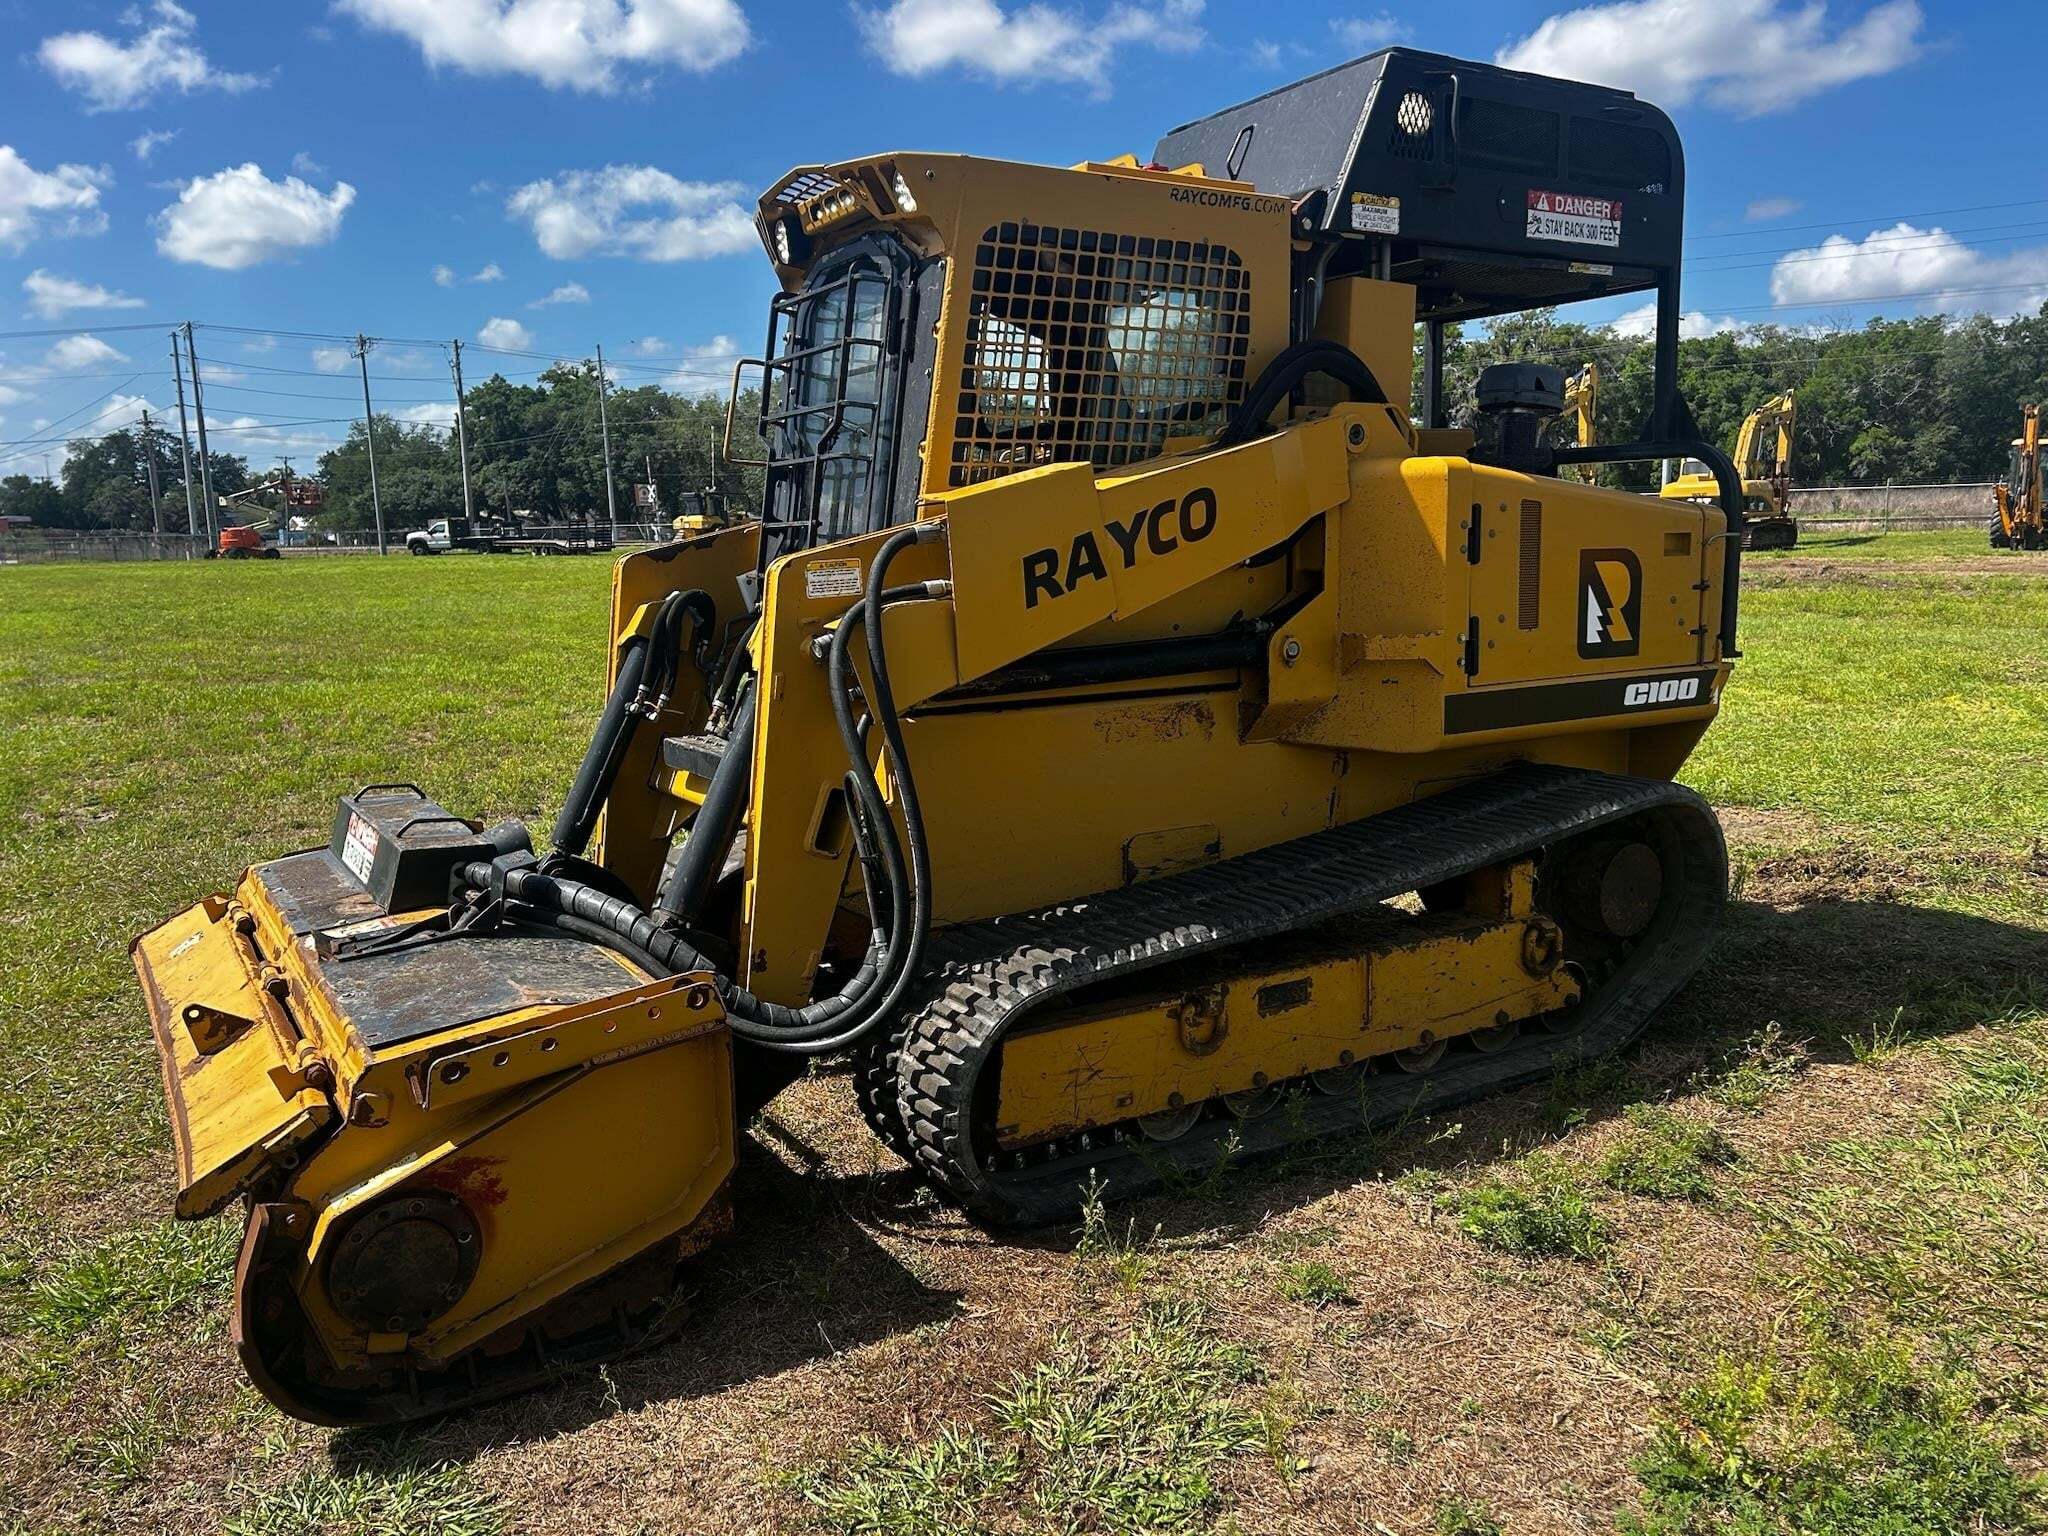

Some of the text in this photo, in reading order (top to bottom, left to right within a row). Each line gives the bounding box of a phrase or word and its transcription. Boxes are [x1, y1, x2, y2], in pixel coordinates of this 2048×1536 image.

[1170, 187, 1285, 213] RAYCOMFG.COM
[1555, 196, 1611, 218] DANGER
[1545, 218, 1563, 235] STAY
[1564, 220, 1584, 238] BACK
[1586, 223, 1598, 240] 300
[1022, 487, 1217, 609] RAYCO
[1624, 678, 1699, 706] C100
